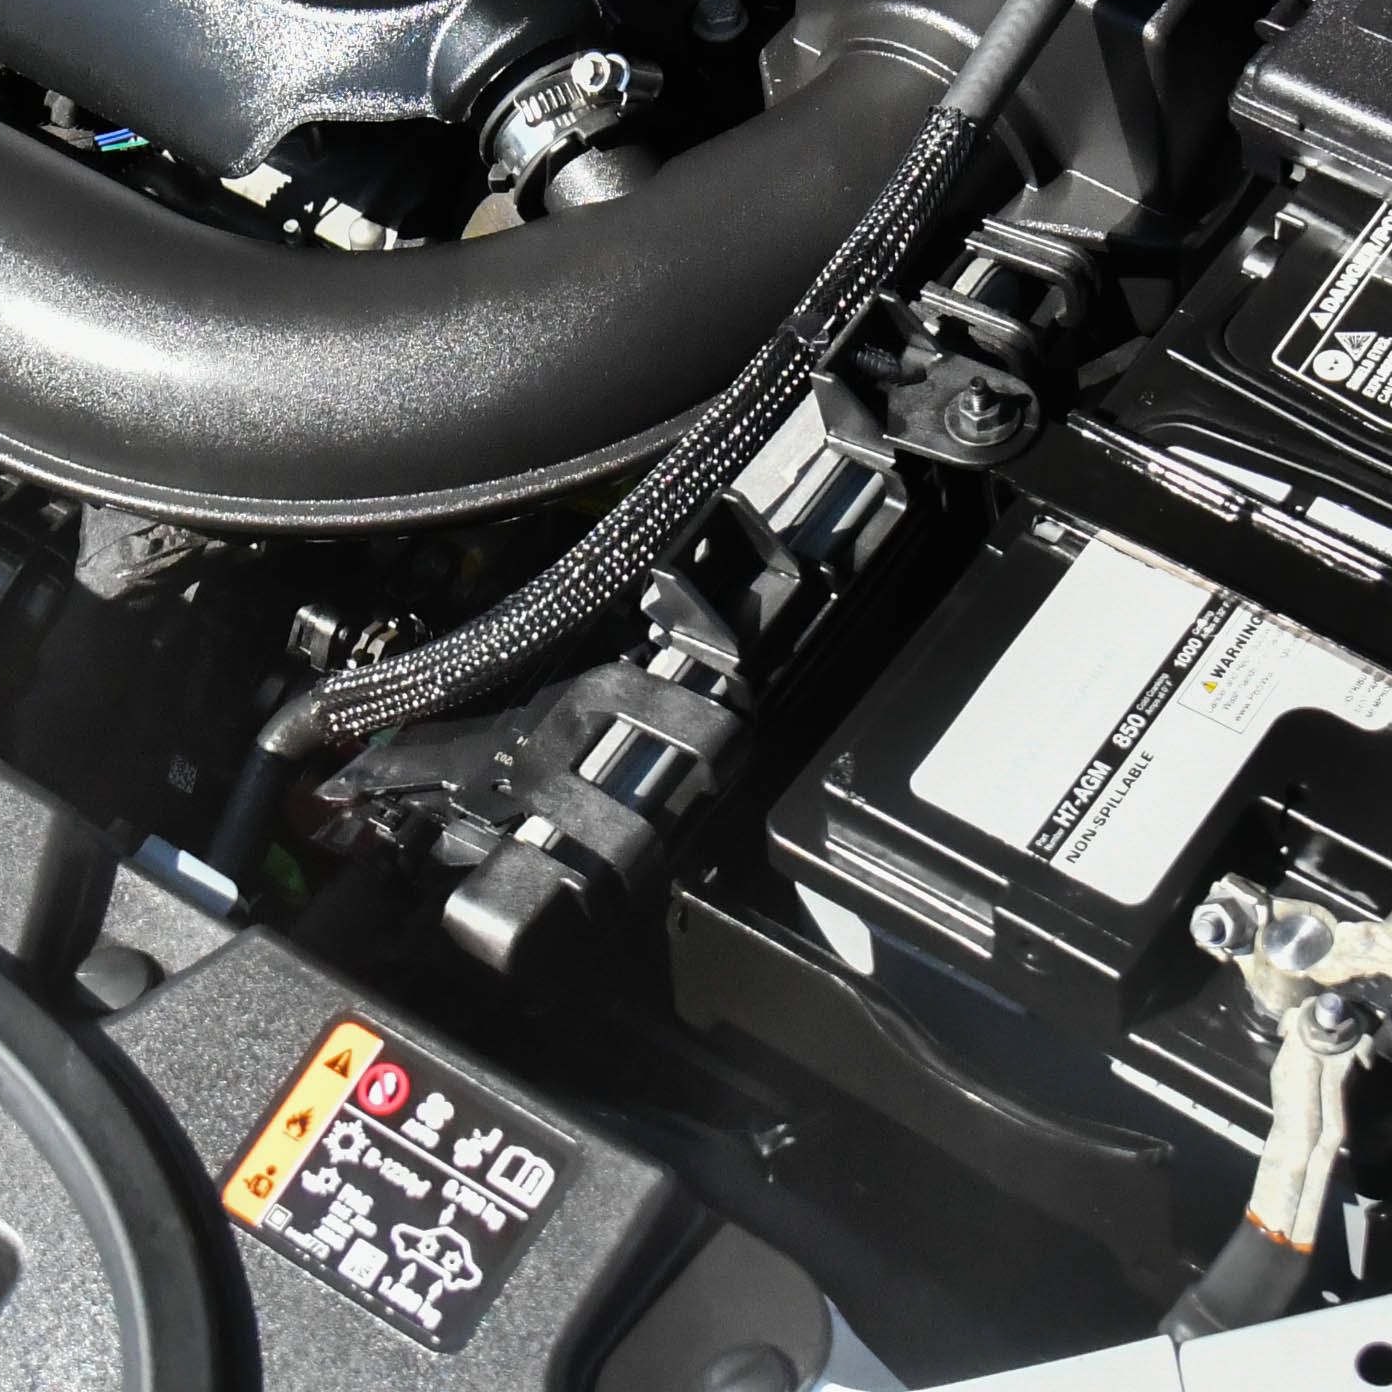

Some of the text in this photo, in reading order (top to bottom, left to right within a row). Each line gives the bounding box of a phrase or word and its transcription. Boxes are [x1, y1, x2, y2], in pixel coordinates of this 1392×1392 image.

[1174, 637, 1203, 669] 1000
[1112, 713, 1147, 749] 850
[1052, 759, 1112, 828] H7-AGM
[1065, 750, 1154, 864] NON-SPILLABLE
